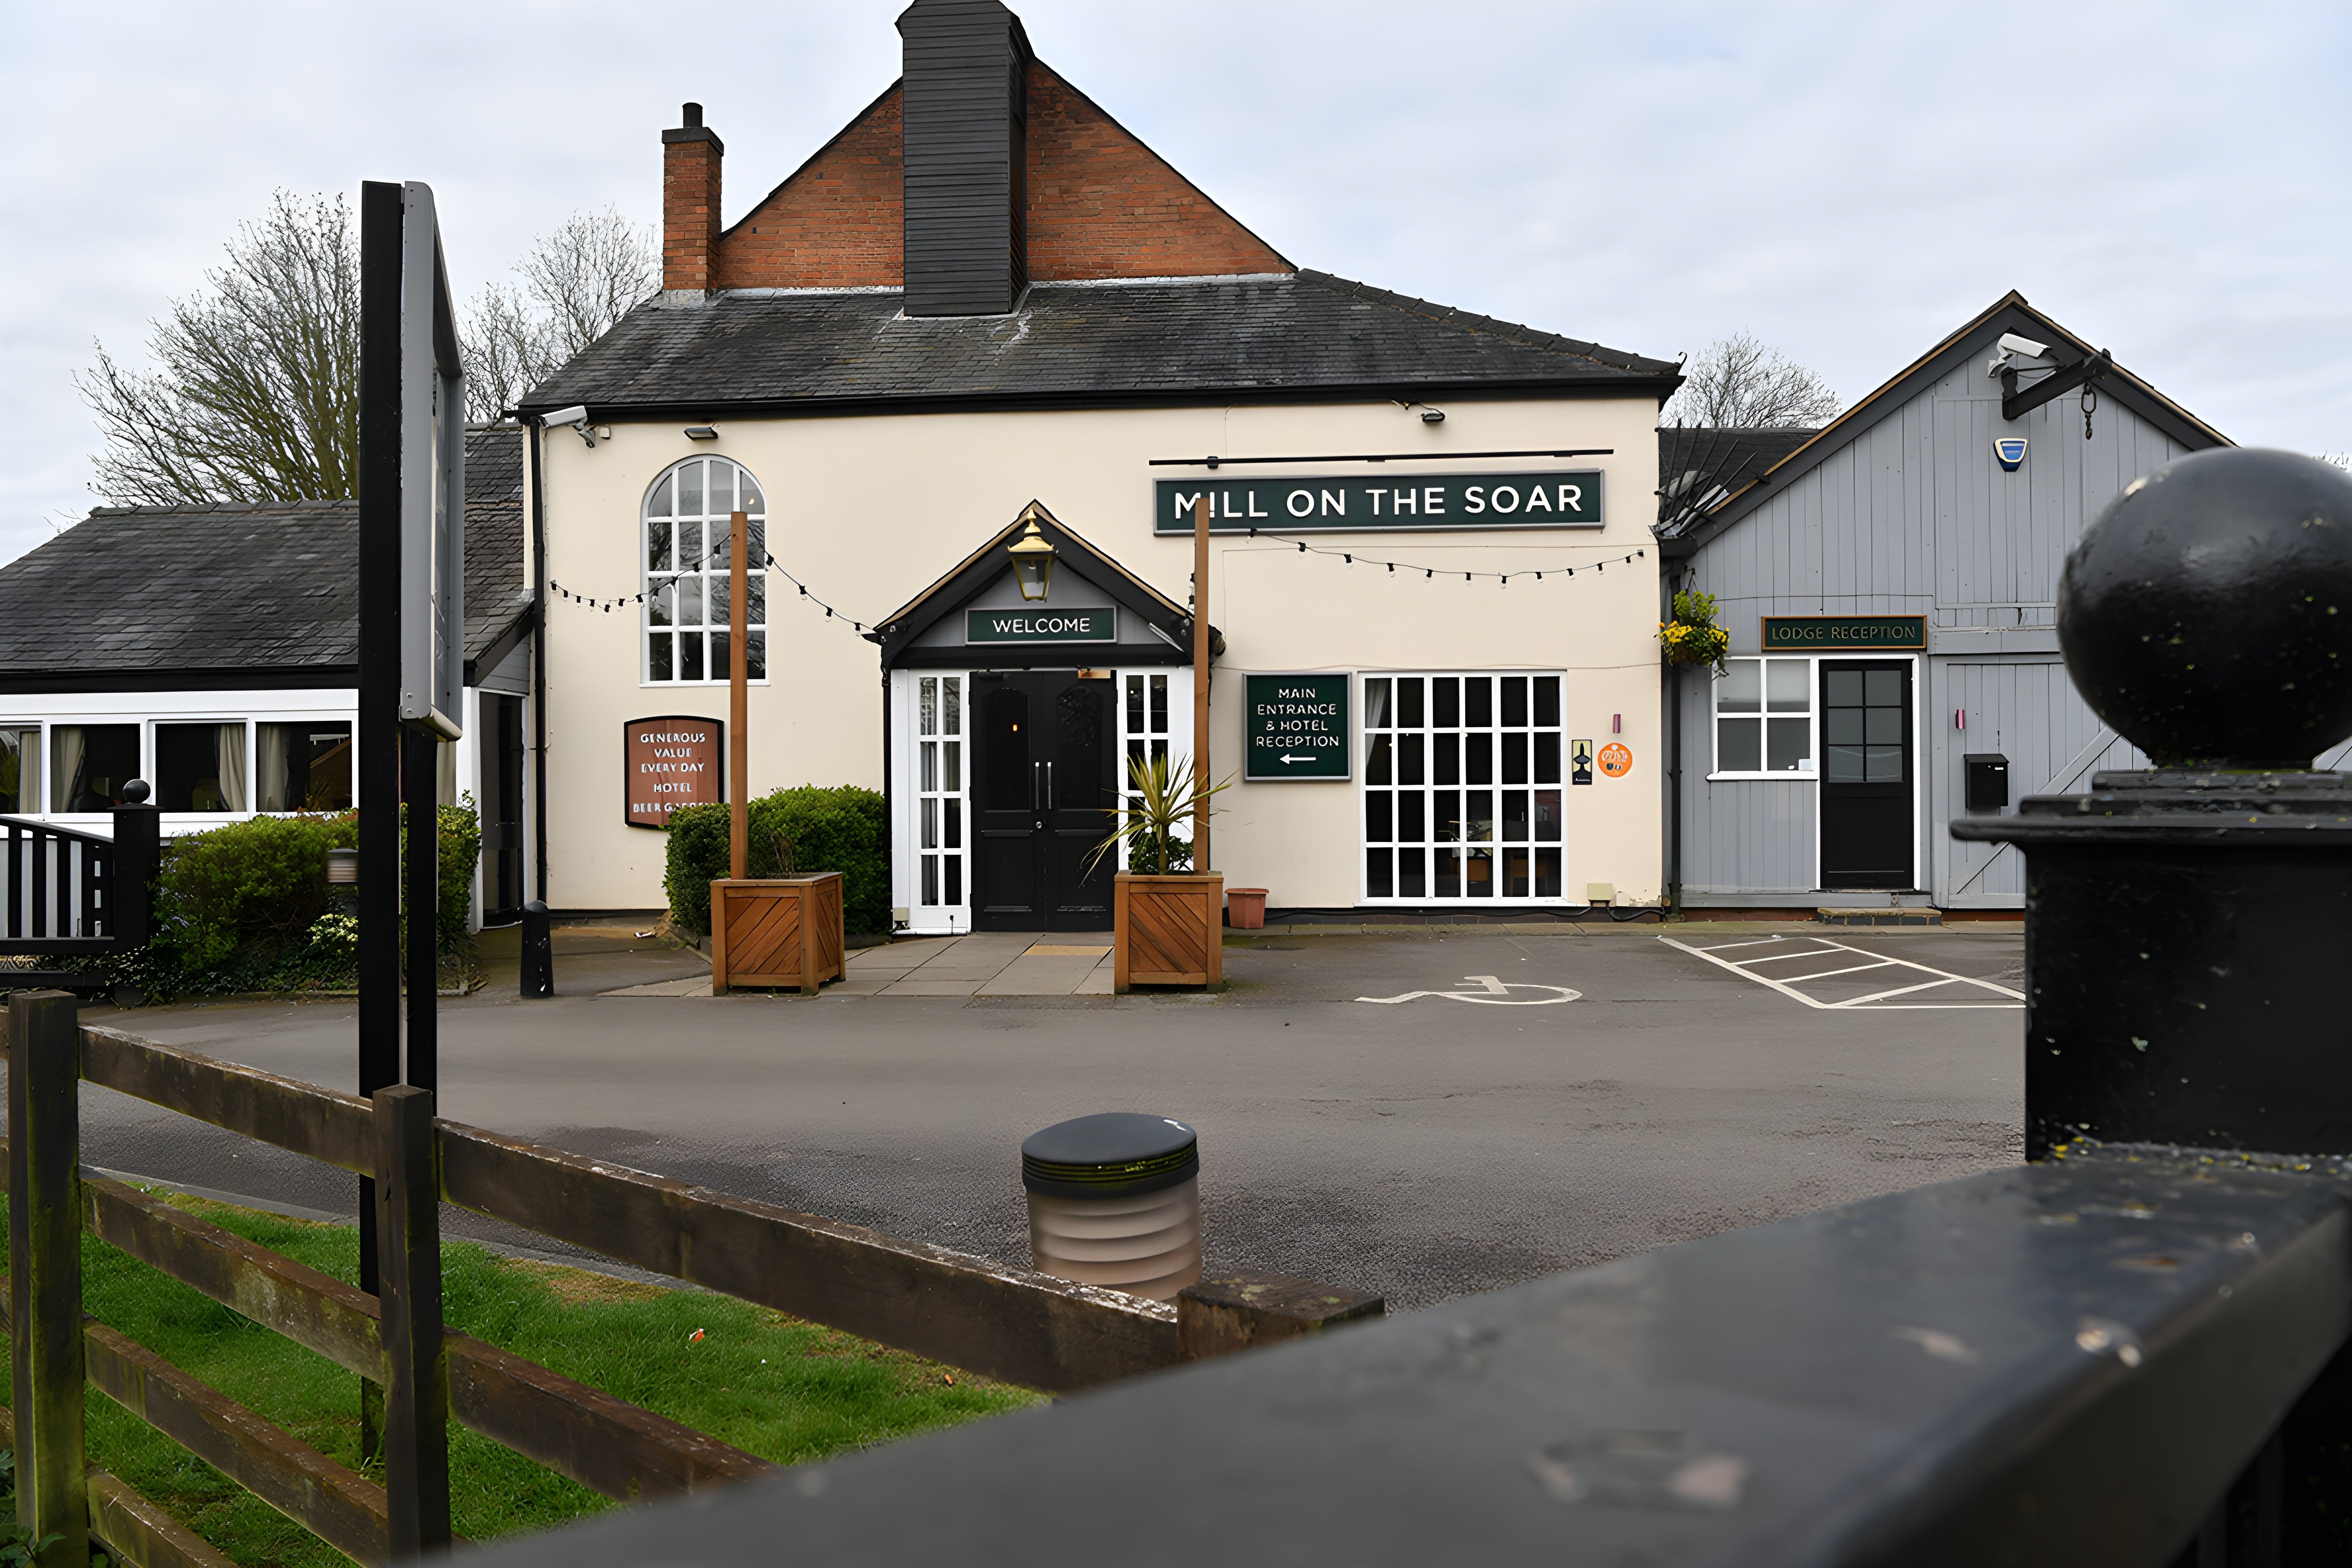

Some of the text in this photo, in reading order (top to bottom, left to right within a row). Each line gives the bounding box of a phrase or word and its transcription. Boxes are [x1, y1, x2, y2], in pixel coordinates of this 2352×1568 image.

[1176, 485, 1582, 519] MILL ON THE SOAR
[993, 618, 1090, 633] WELCOME
[1772, 626, 1915, 640] LODGE RECEPTION
[1278, 688, 1315, 698] MAIN
[1257, 704, 1336, 715] ENTRANCE
[1266, 720, 1328, 731] & HOTEL
[640, 733, 705, 743] GENEROUS
[1256, 736, 1339, 747] RECEPTION
[654, 748, 691, 758] VALUE
[641, 762, 705, 773] EVERY DAY
[654, 783, 692, 792] HOTEL
[633, 803, 661, 813] BEER
